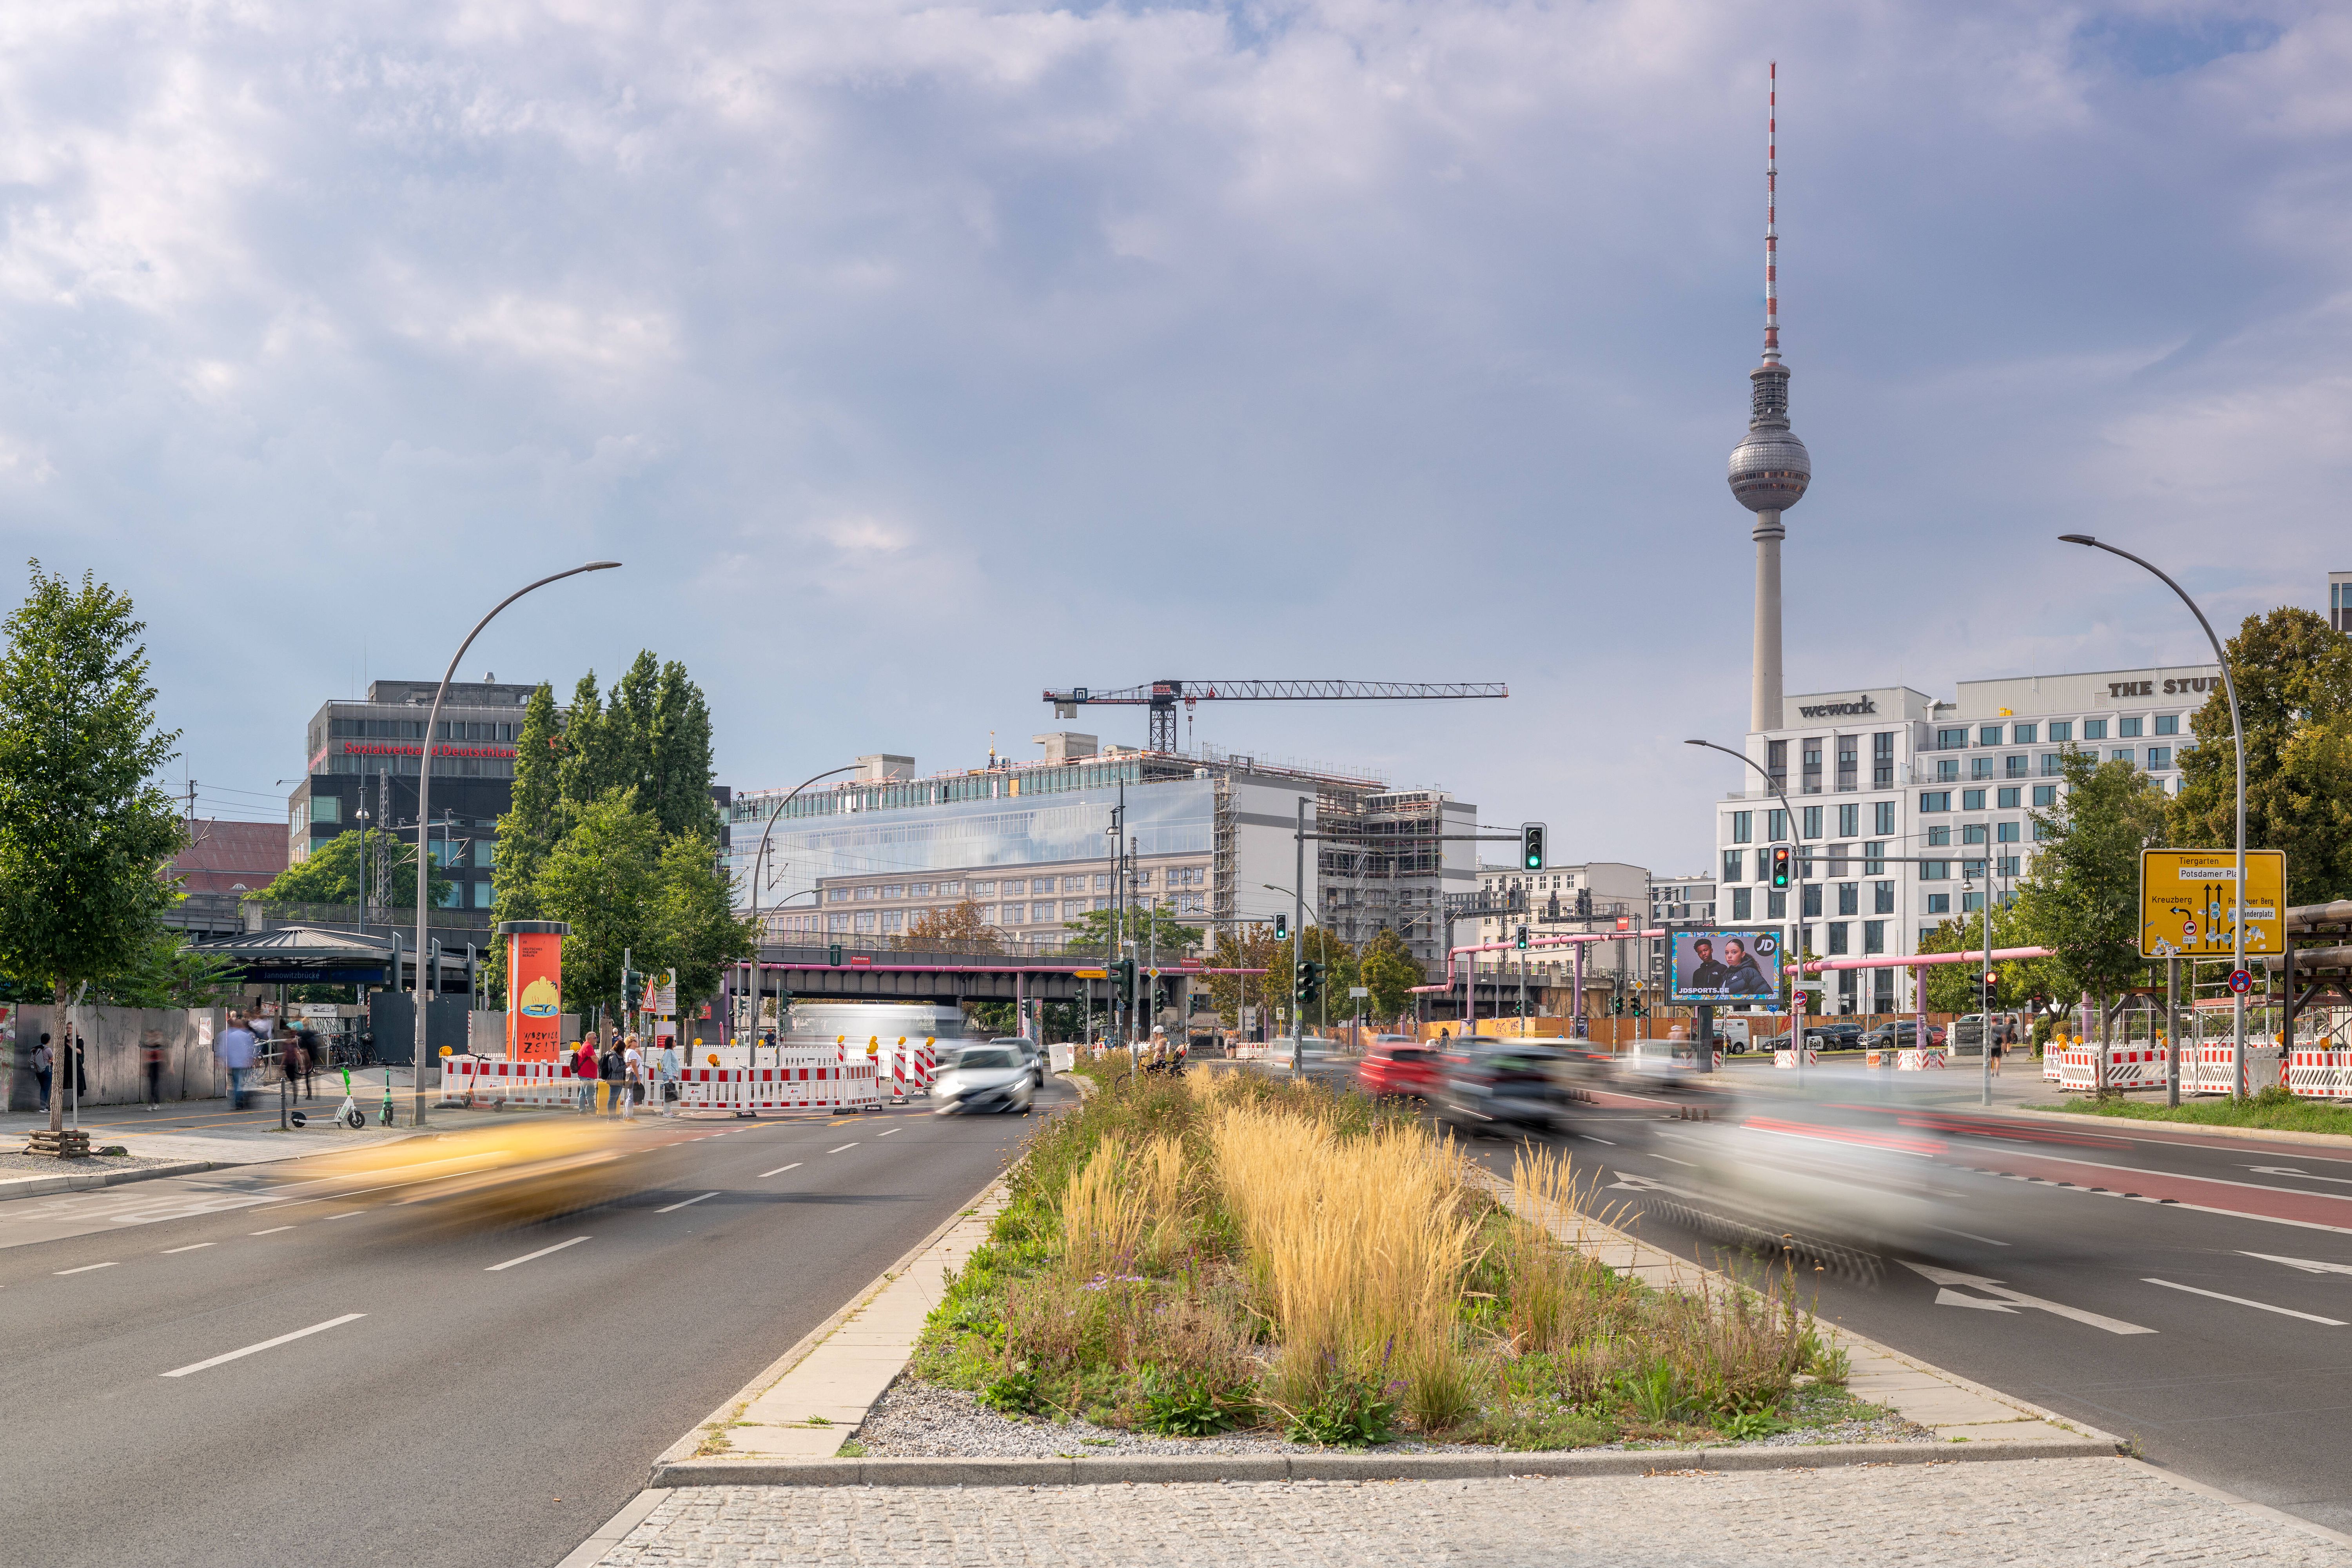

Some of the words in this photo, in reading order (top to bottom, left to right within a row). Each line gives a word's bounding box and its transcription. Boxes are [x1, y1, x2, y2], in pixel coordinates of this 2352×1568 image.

[2109, 681, 2152, 697] THE
[1798, 694, 1876, 718] wework
[345, 742, 438, 755] Sozialverbad
[443, 745, 517, 757] Deutschlan
[2179, 857, 2219, 866] Tiergarten
[2152, 896, 2192, 904] Kreuzberg
[2261, 897, 2274, 906] Berg
[1757, 939, 1775, 951] JD
[264, 970, 320, 979] Jannowitzbrücke
